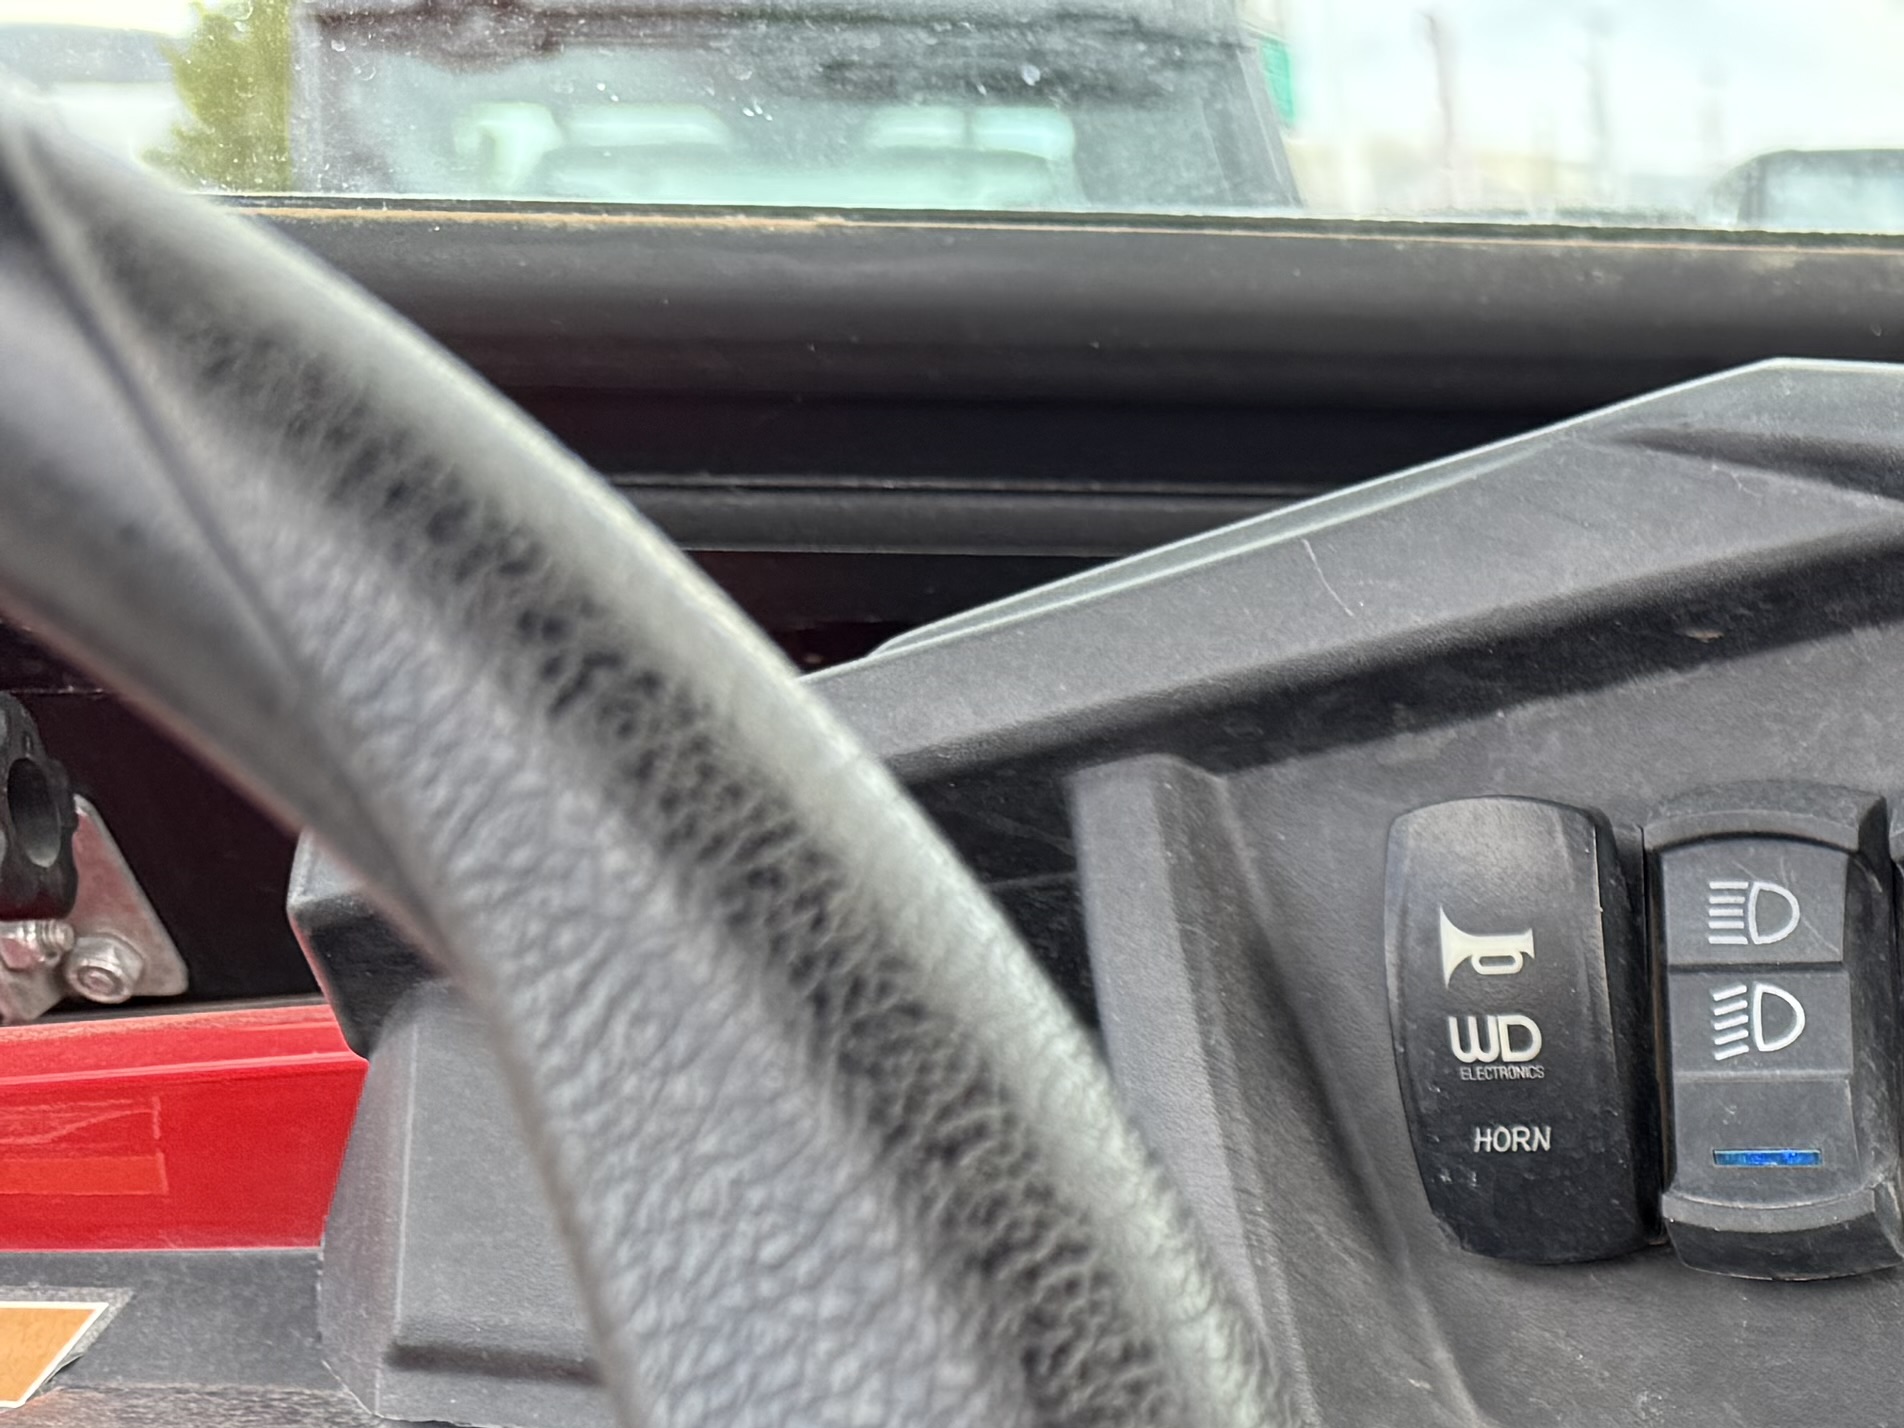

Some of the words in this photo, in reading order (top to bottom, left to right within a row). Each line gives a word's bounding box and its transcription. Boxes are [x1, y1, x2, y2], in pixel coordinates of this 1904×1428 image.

[1448, 1014, 1543, 1063] WD
[1459, 1065, 1545, 1081] ELECTRONICS
[1473, 1125, 1552, 1152] HORN
